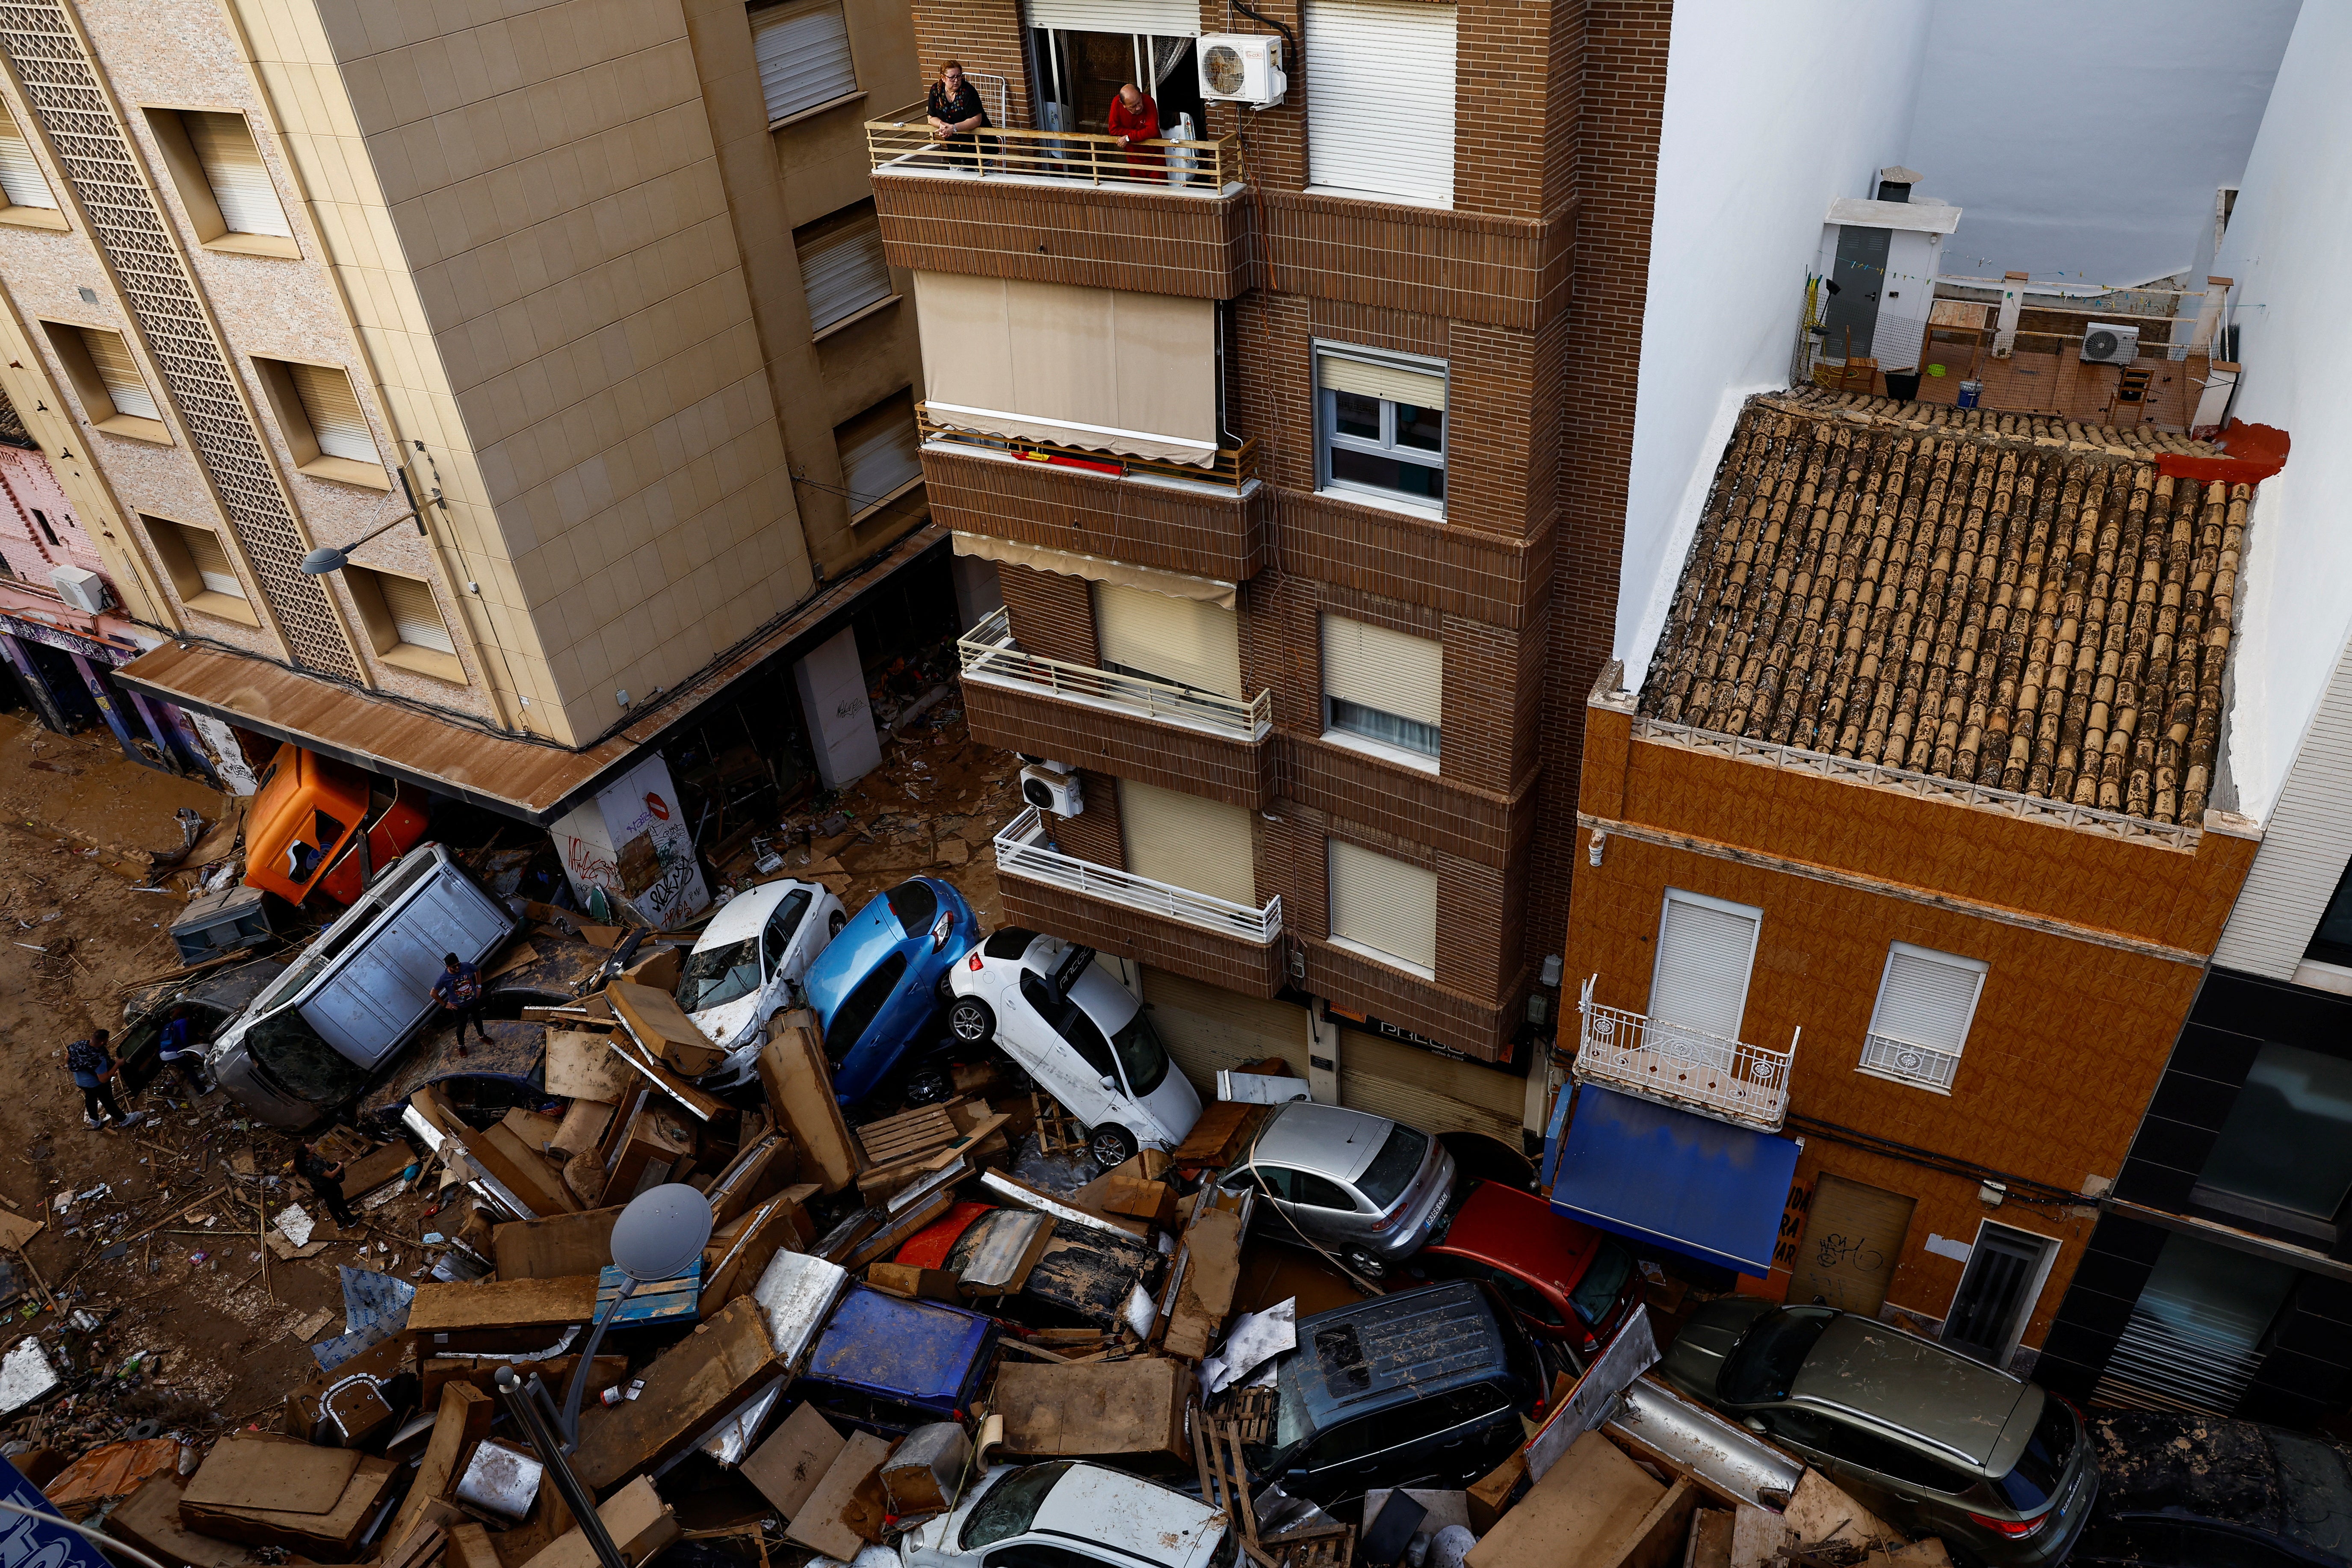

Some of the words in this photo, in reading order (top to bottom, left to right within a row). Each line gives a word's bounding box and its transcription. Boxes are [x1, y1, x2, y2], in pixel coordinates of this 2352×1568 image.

[1059, 946, 1091, 989] PREGO
[1427, 1206, 1439, 1224] 9366
[1437, 1192, 1446, 1207] CYC
